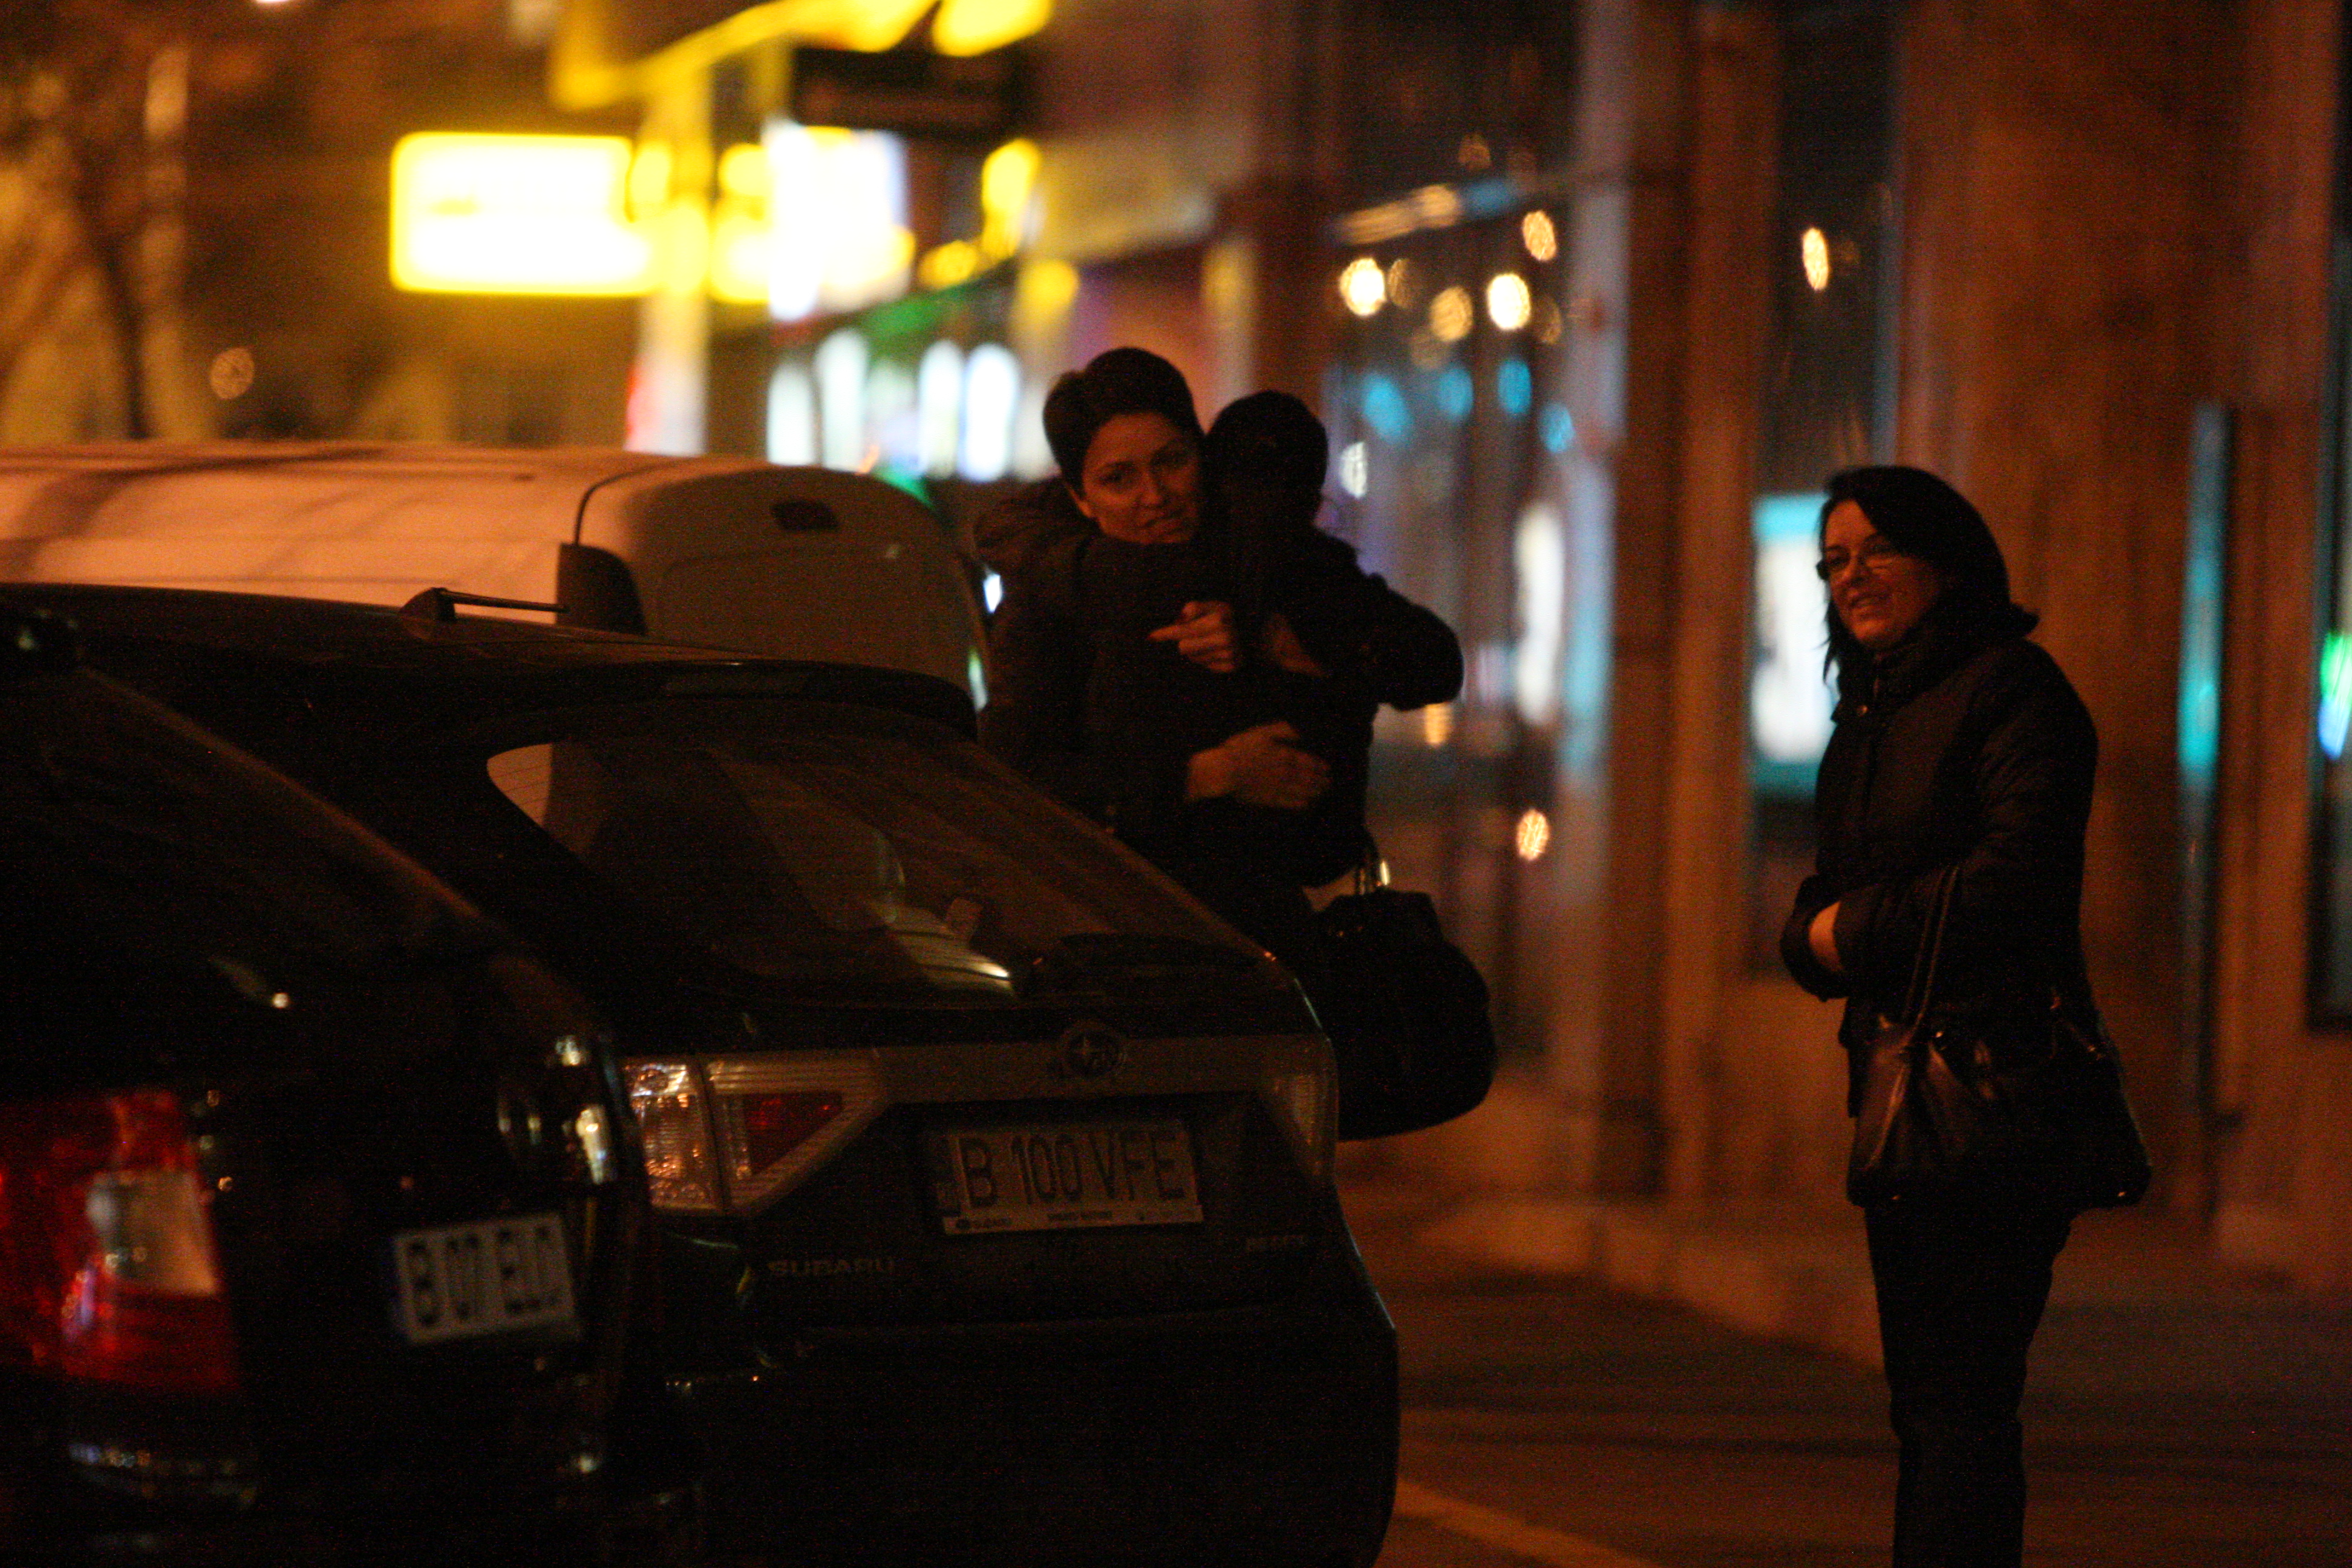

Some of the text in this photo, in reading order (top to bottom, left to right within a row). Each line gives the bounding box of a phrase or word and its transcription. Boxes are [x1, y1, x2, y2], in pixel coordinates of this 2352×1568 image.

[960, 1126, 1185, 1207] B 100 VFE
[408, 1241, 440, 1328] B
[766, 1258, 895, 1277] SUBARU
